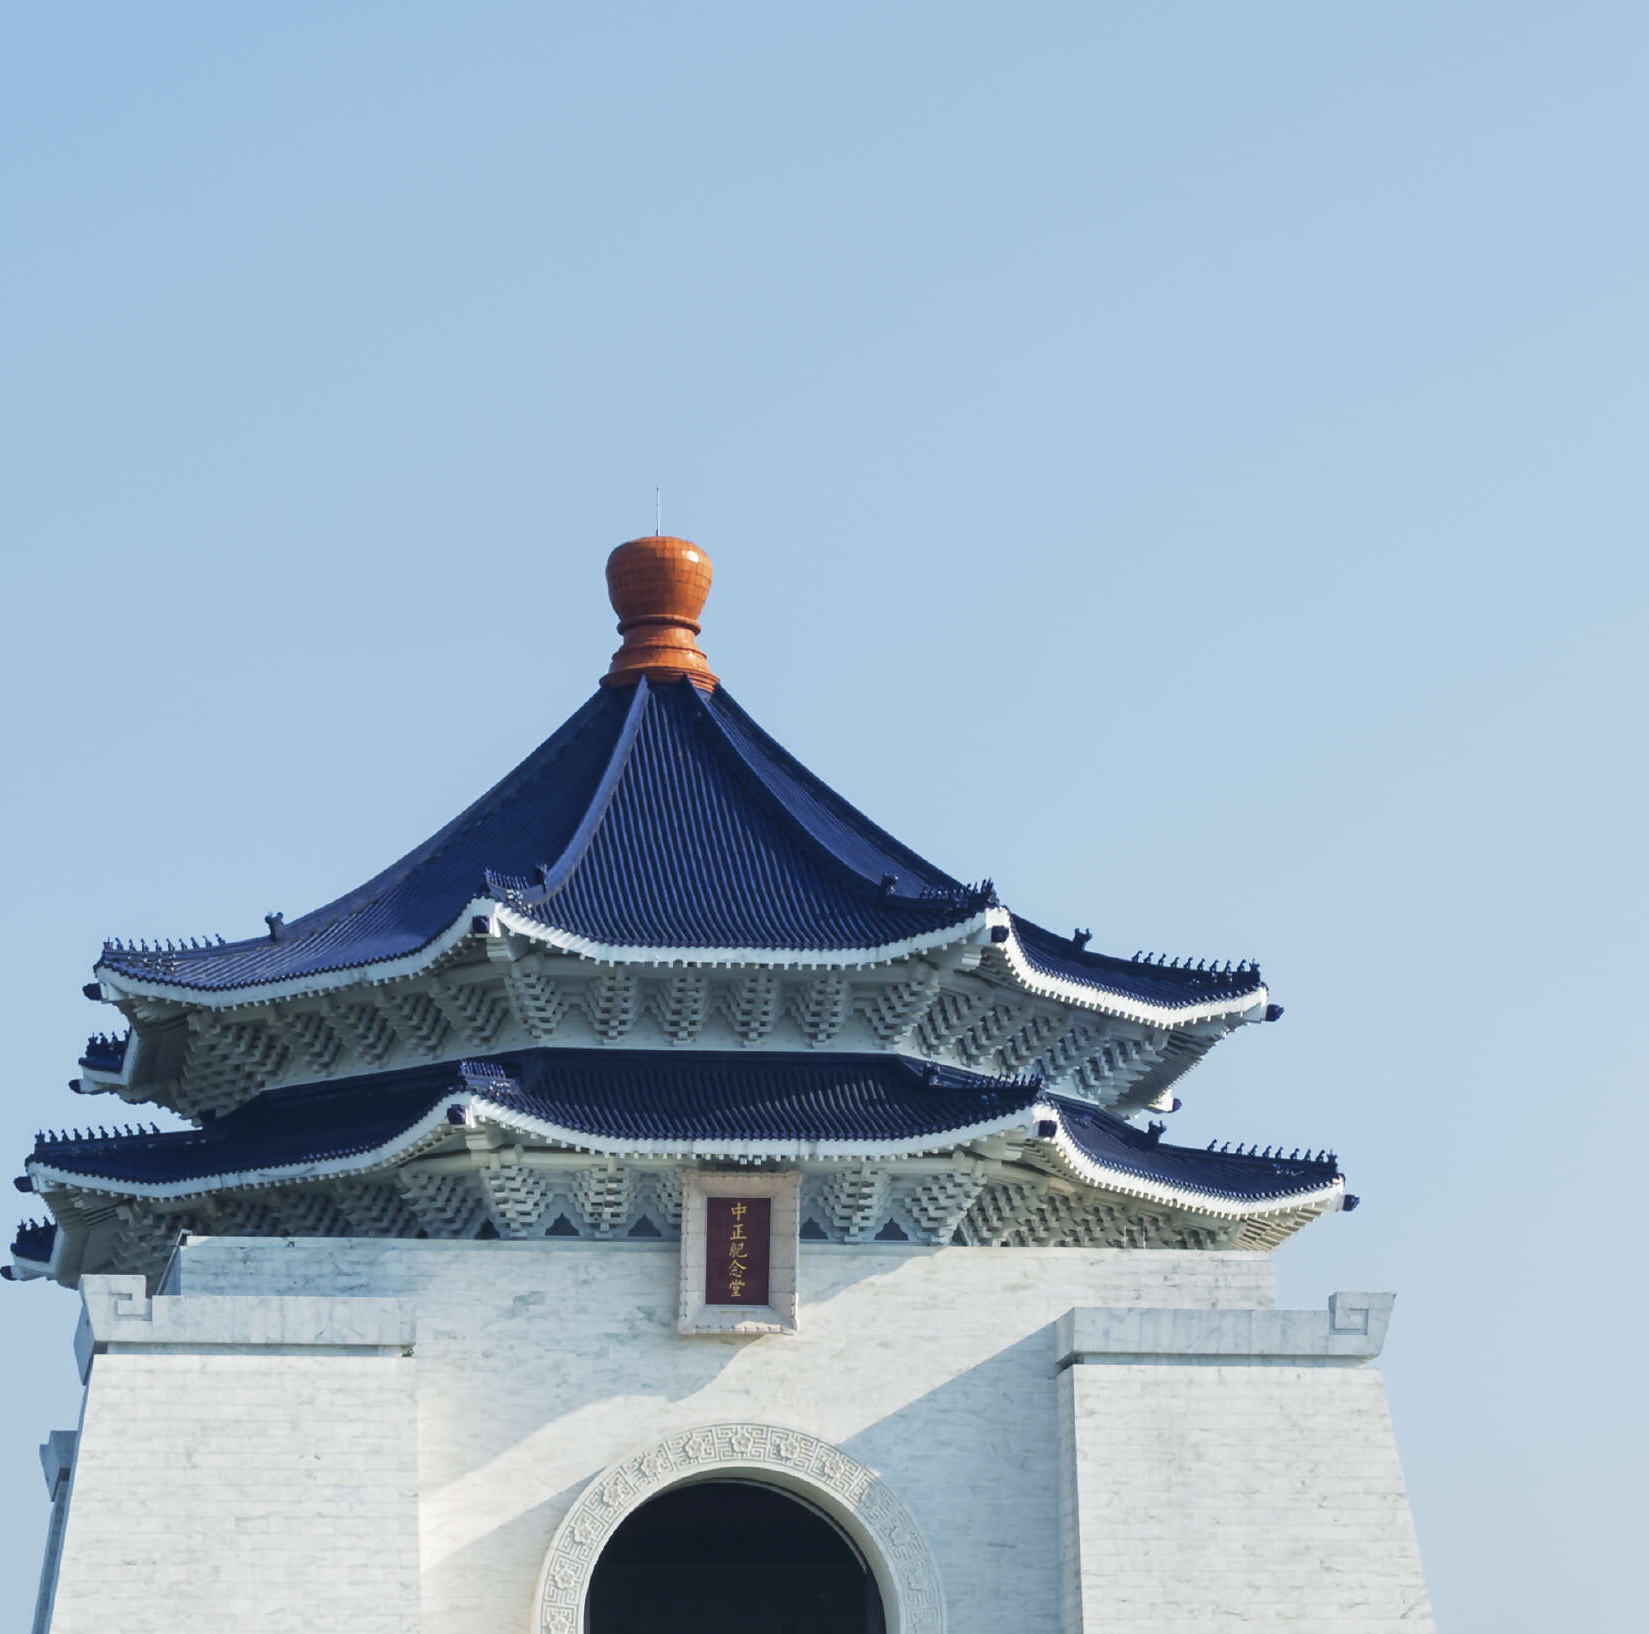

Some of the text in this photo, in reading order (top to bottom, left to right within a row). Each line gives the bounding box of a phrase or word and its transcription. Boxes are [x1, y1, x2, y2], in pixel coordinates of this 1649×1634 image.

[729, 1202, 748, 1297] 中正紀念堂
